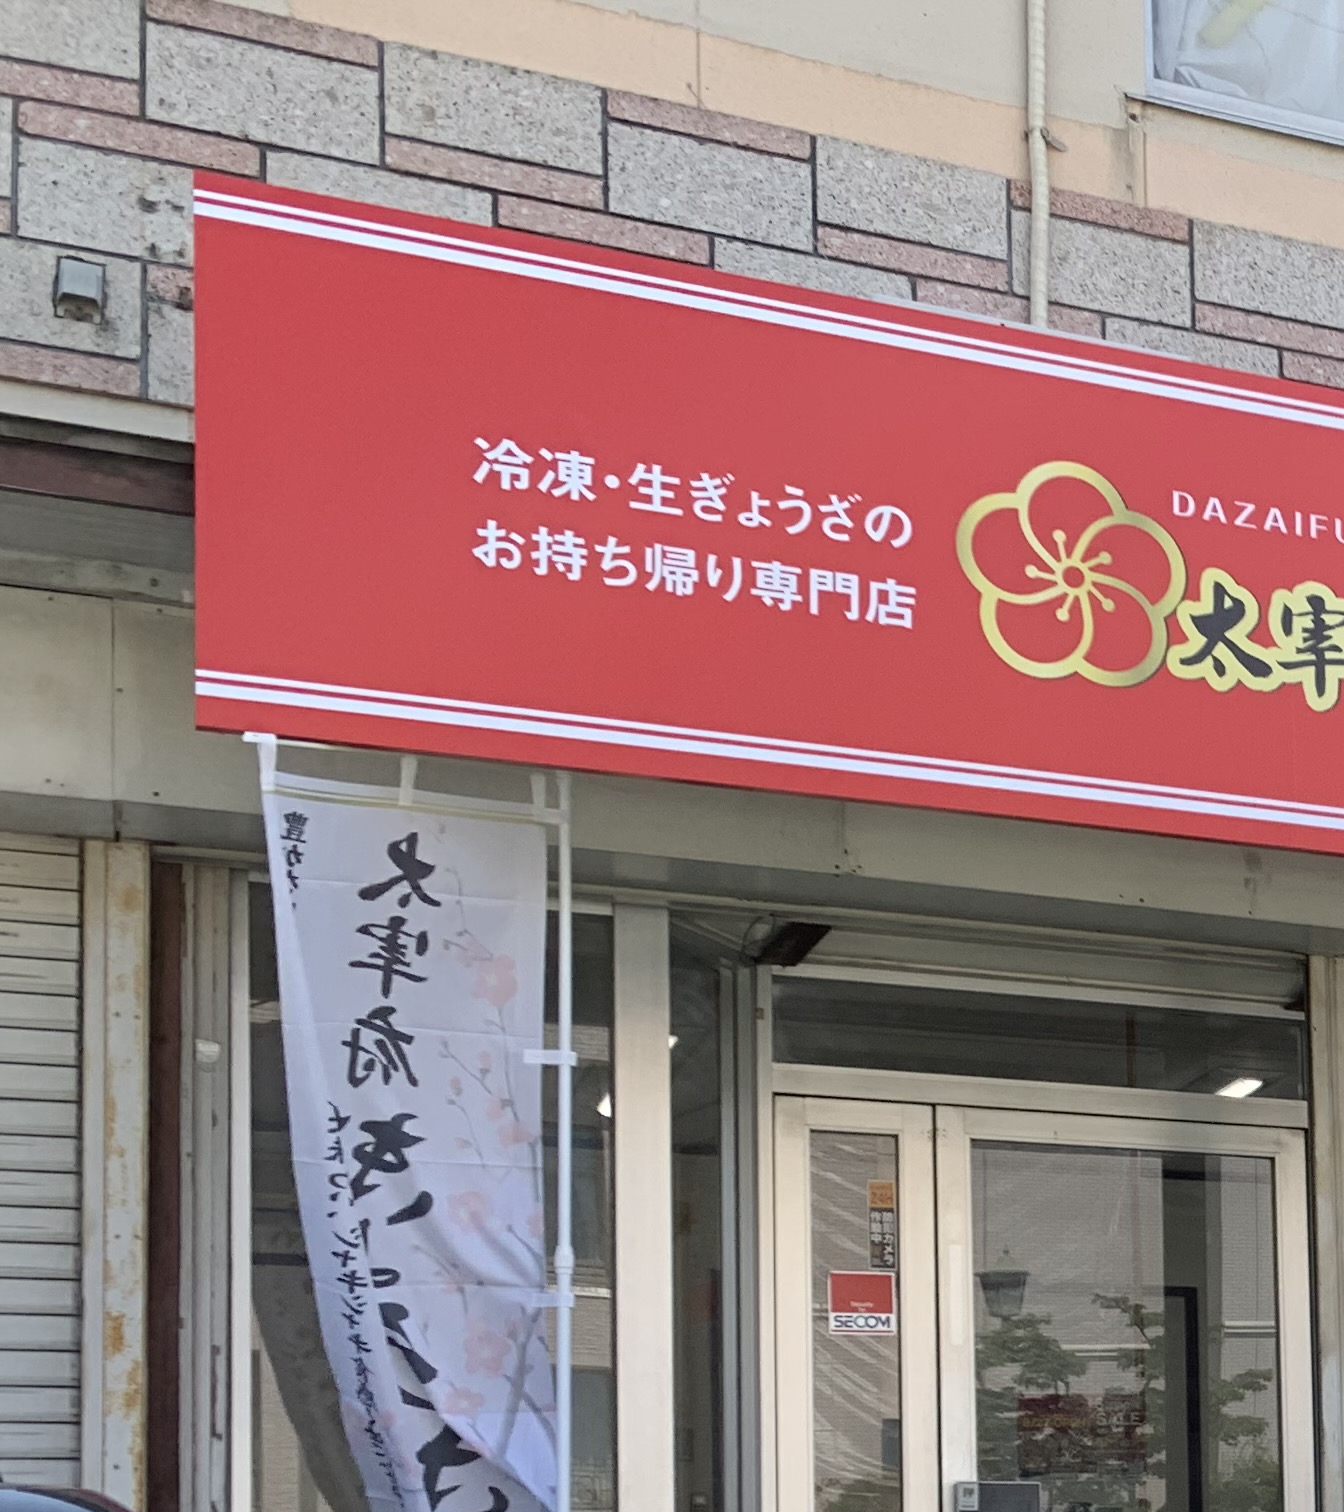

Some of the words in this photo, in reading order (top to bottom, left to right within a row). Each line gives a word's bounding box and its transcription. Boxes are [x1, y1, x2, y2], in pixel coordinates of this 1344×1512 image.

[472, 436, 913, 549] 冷凍・生ぎょうざの
[472, 518, 917, 630] お持ち帰り専門店
[834, 1315, 891, 1329] SECOM
